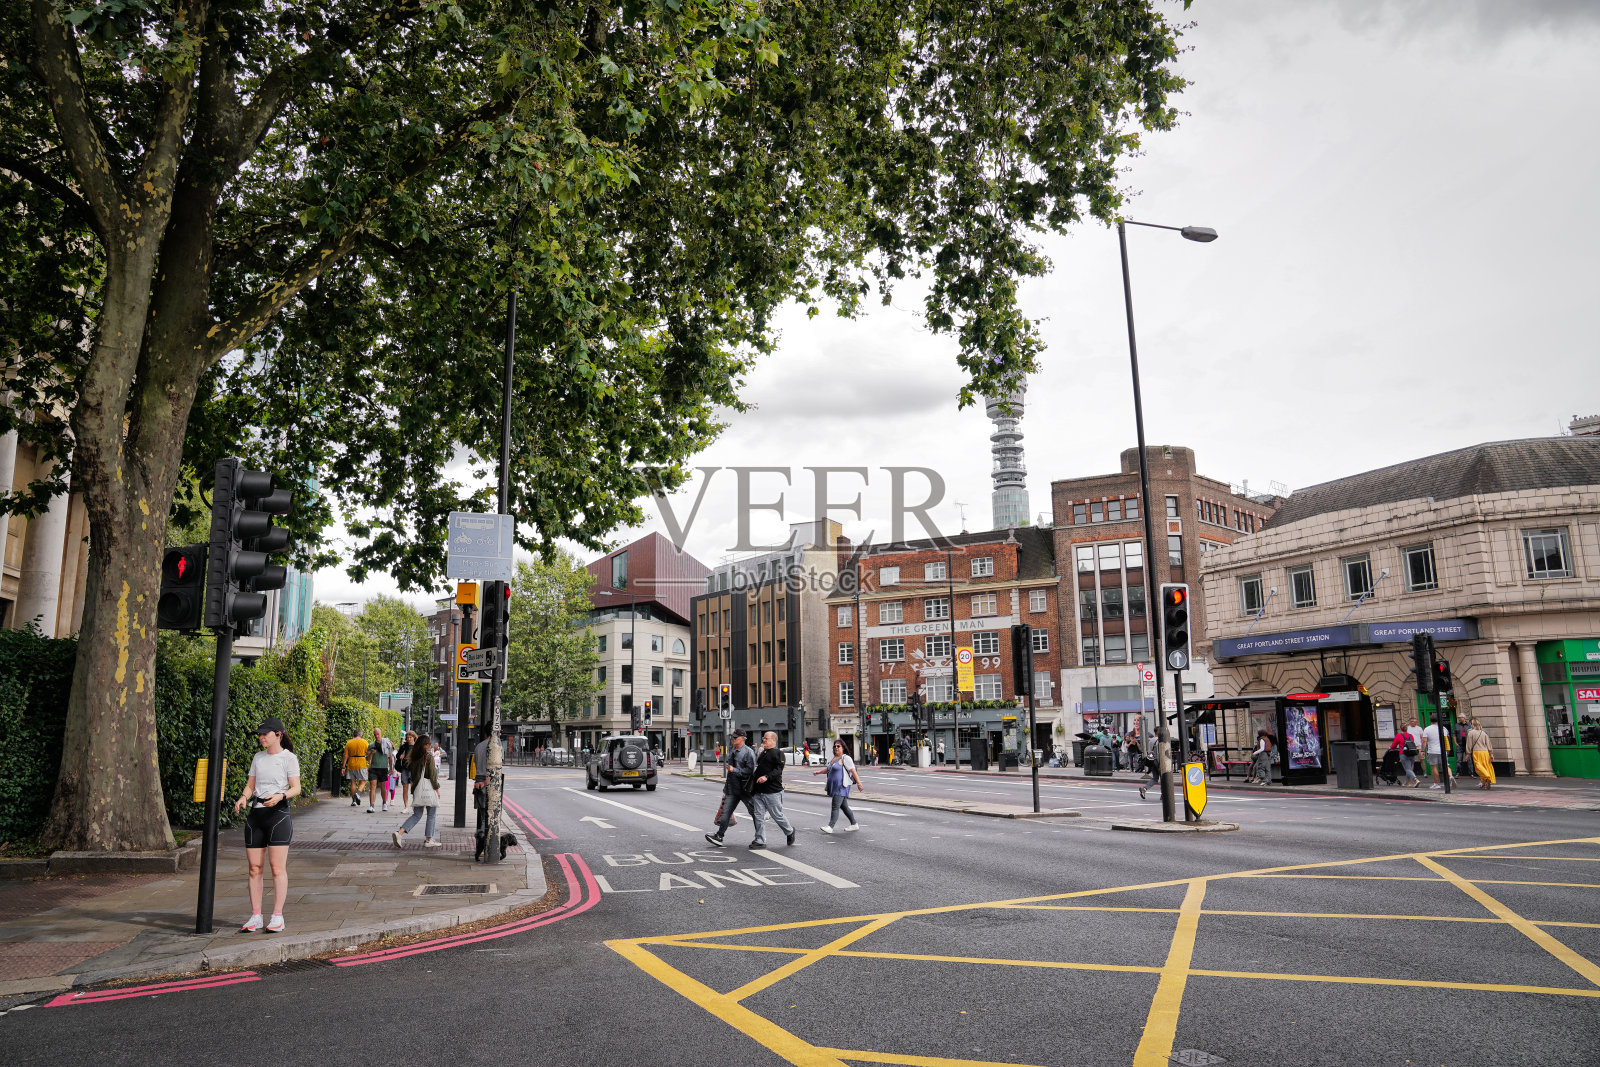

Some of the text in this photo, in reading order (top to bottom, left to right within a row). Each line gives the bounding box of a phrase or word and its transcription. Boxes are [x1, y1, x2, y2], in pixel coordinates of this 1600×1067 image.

[890, 620, 985, 634] THE GREEN MAN
[1398, 627, 1436, 635] PORTLAND
[1236, 634, 1330, 650] GREAT PORTLAND STREET STATION
[880, 662, 896, 675] 17
[981, 657, 1001, 669] 99
[1578, 689, 1600, 699] SAL
[603, 850, 738, 867] BUS
[594, 867, 815, 893] LANE
